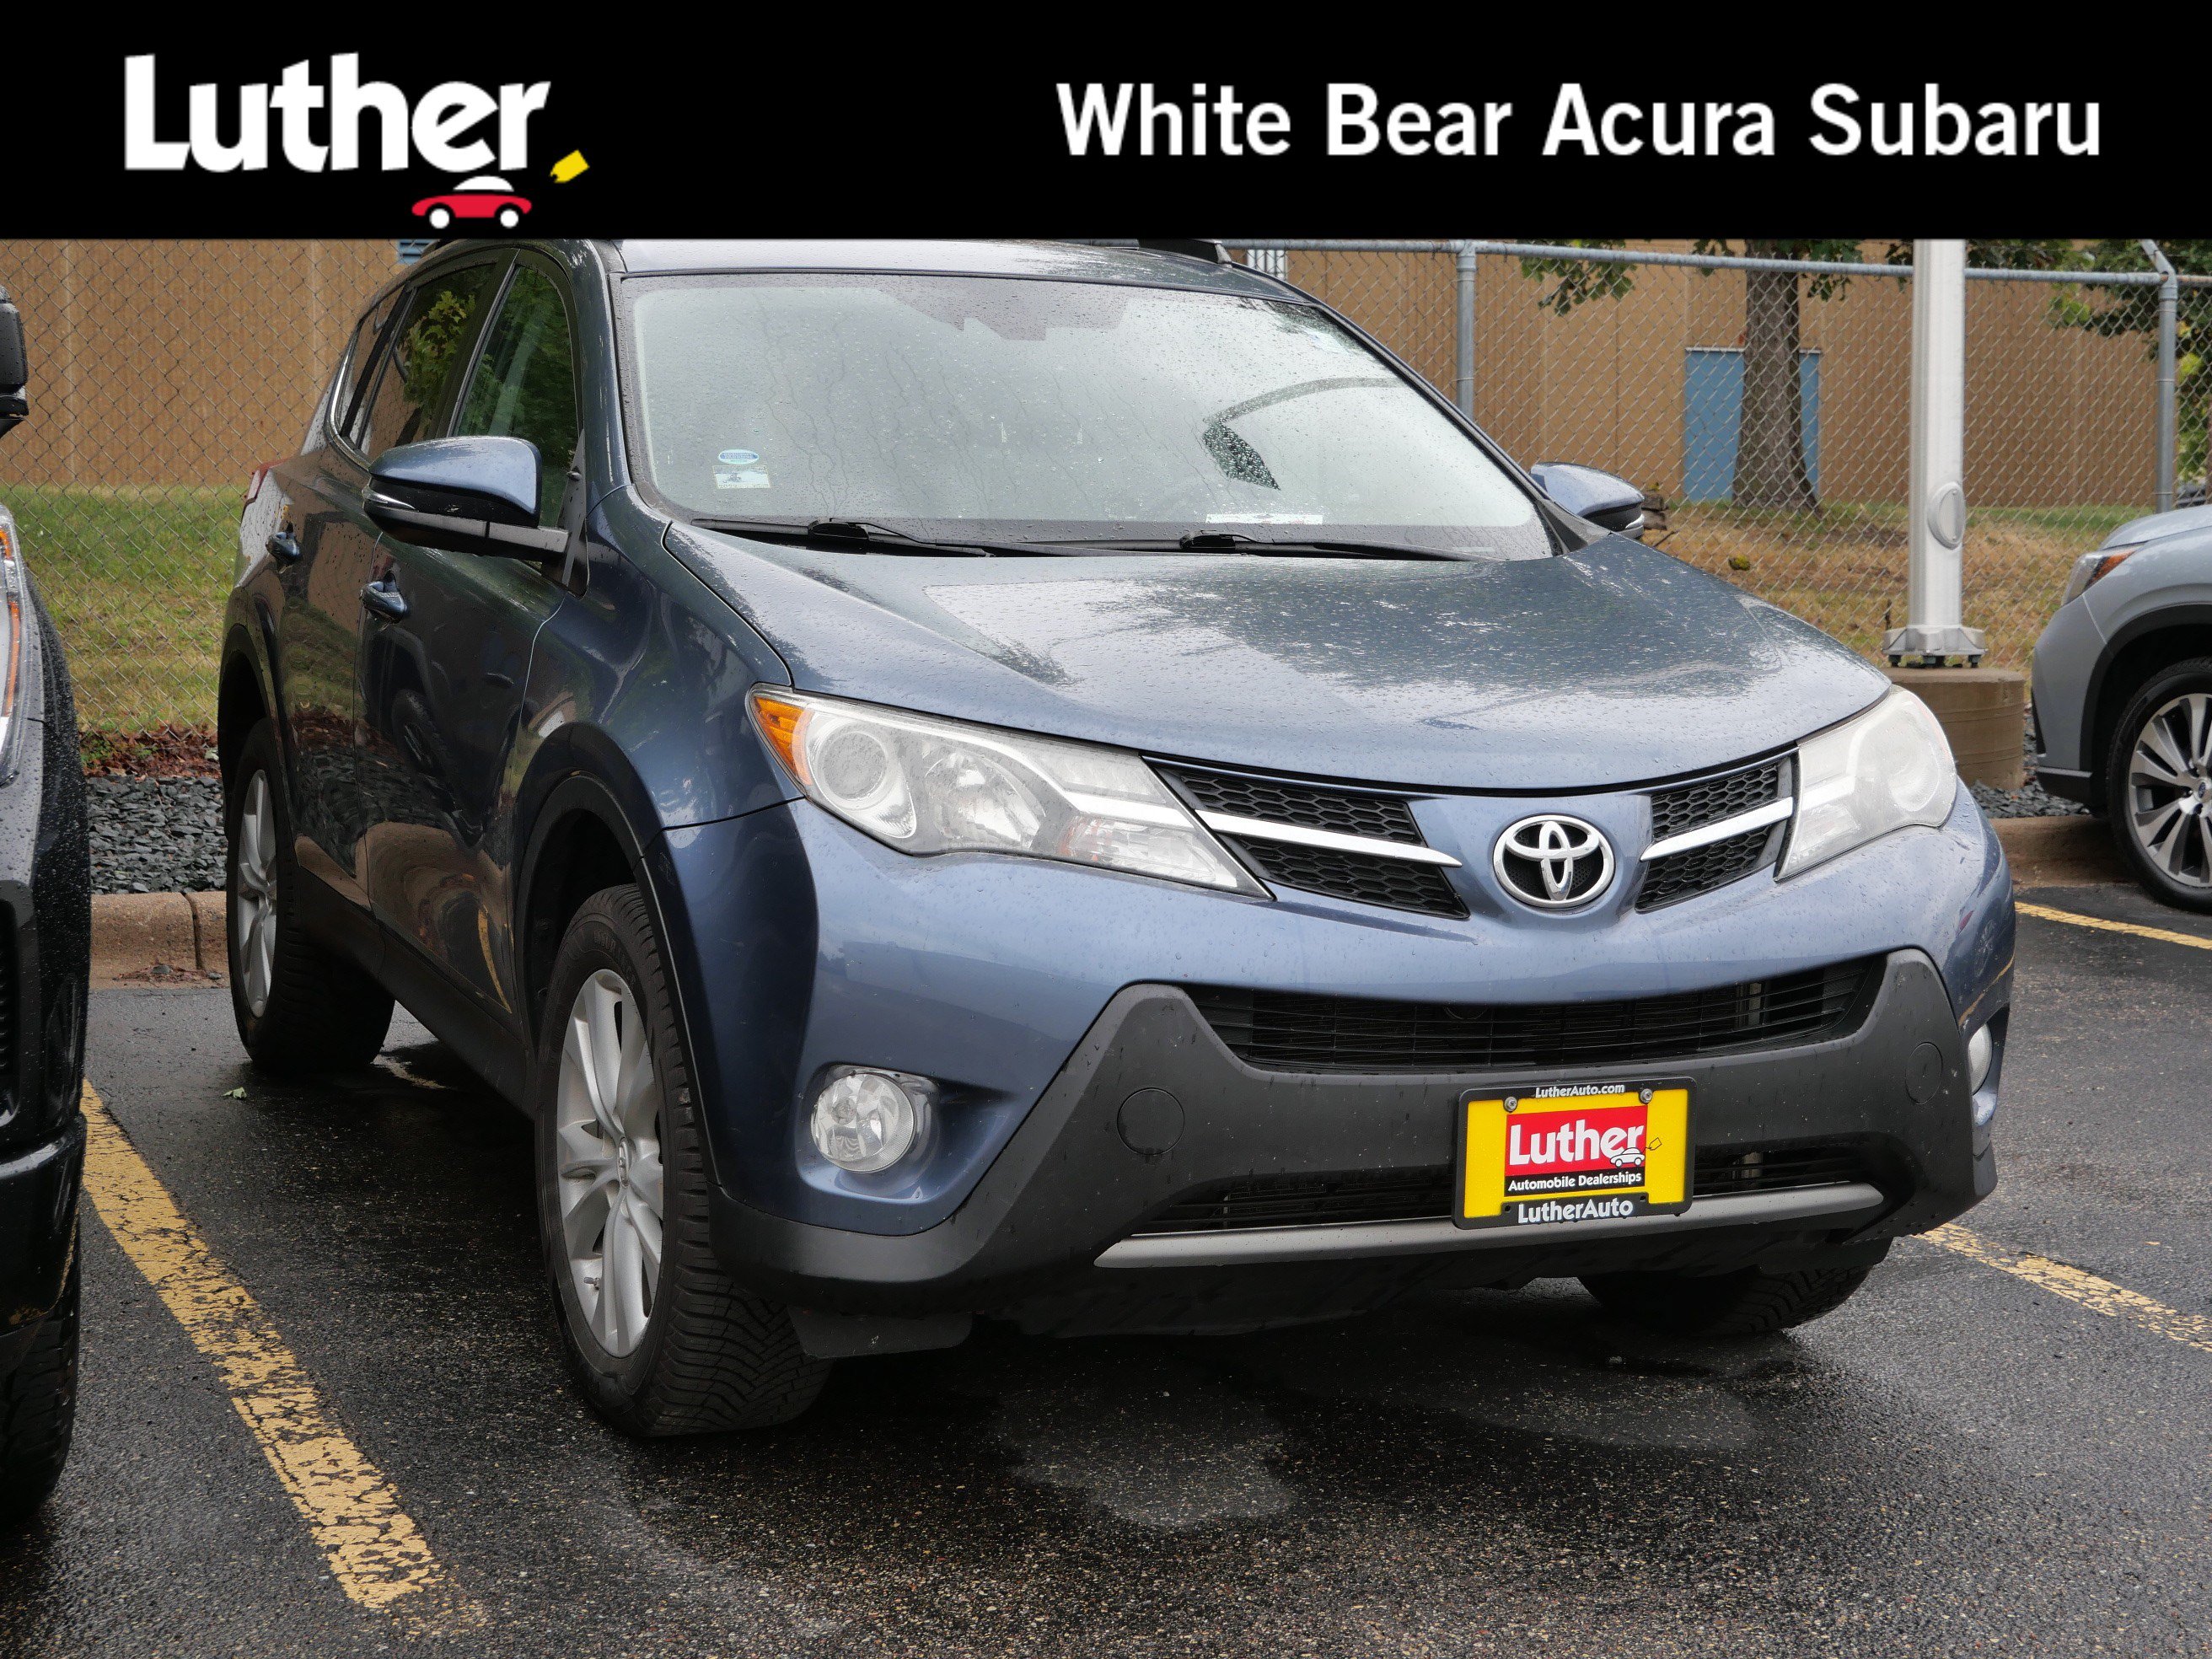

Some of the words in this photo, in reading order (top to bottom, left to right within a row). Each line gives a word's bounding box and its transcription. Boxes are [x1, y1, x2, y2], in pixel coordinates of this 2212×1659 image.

[1535, 1084, 1625, 1098] LutherAuto.com
[1509, 1119, 1645, 1167] Luther
[1507, 1175, 1576, 1192] Automobile
[1578, 1171, 1642, 1187] Dealerships
[1517, 1197, 1634, 1224] LutherAuto
